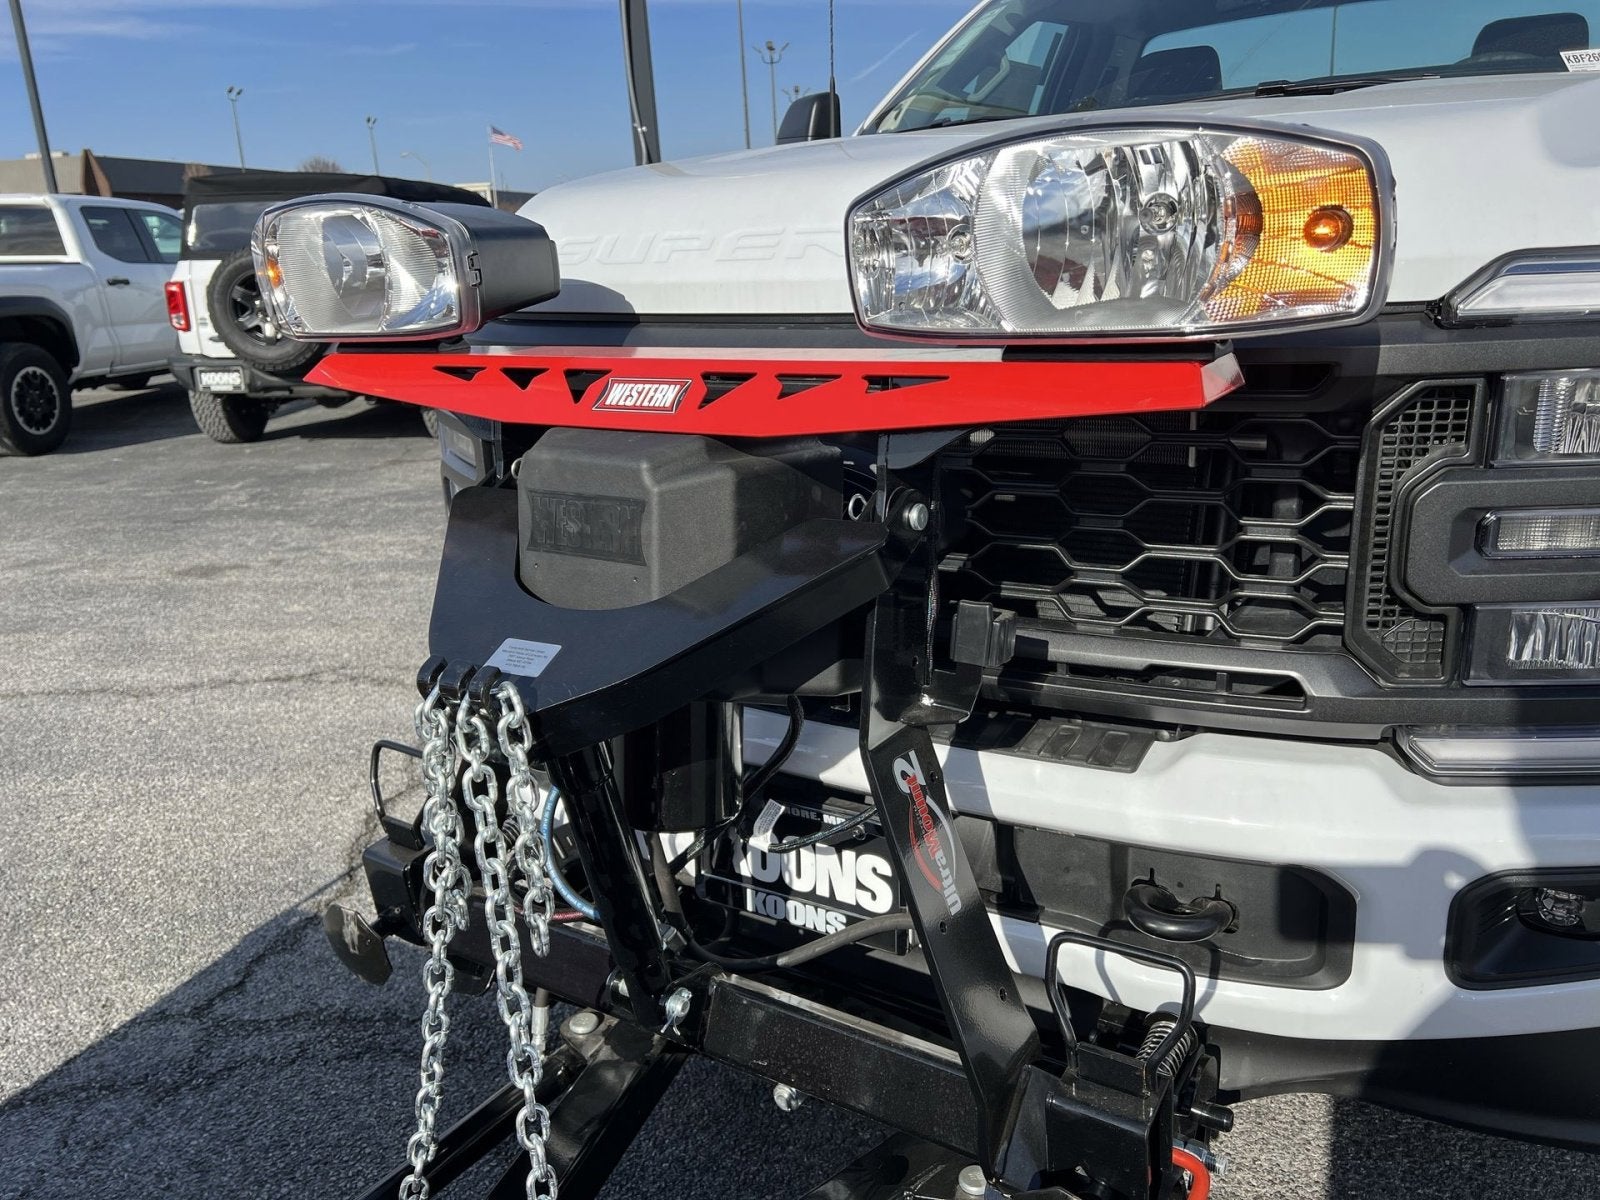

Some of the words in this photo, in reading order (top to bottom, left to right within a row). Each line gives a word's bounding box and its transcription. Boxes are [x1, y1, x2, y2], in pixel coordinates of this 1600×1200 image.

[1565, 53, 1600, 64] KBF26
[201, 372, 241, 385] KOONS
[605, 383, 680, 407] WESTERN
[893, 750, 926, 794] 2
[747, 888, 847, 935] KOONS
